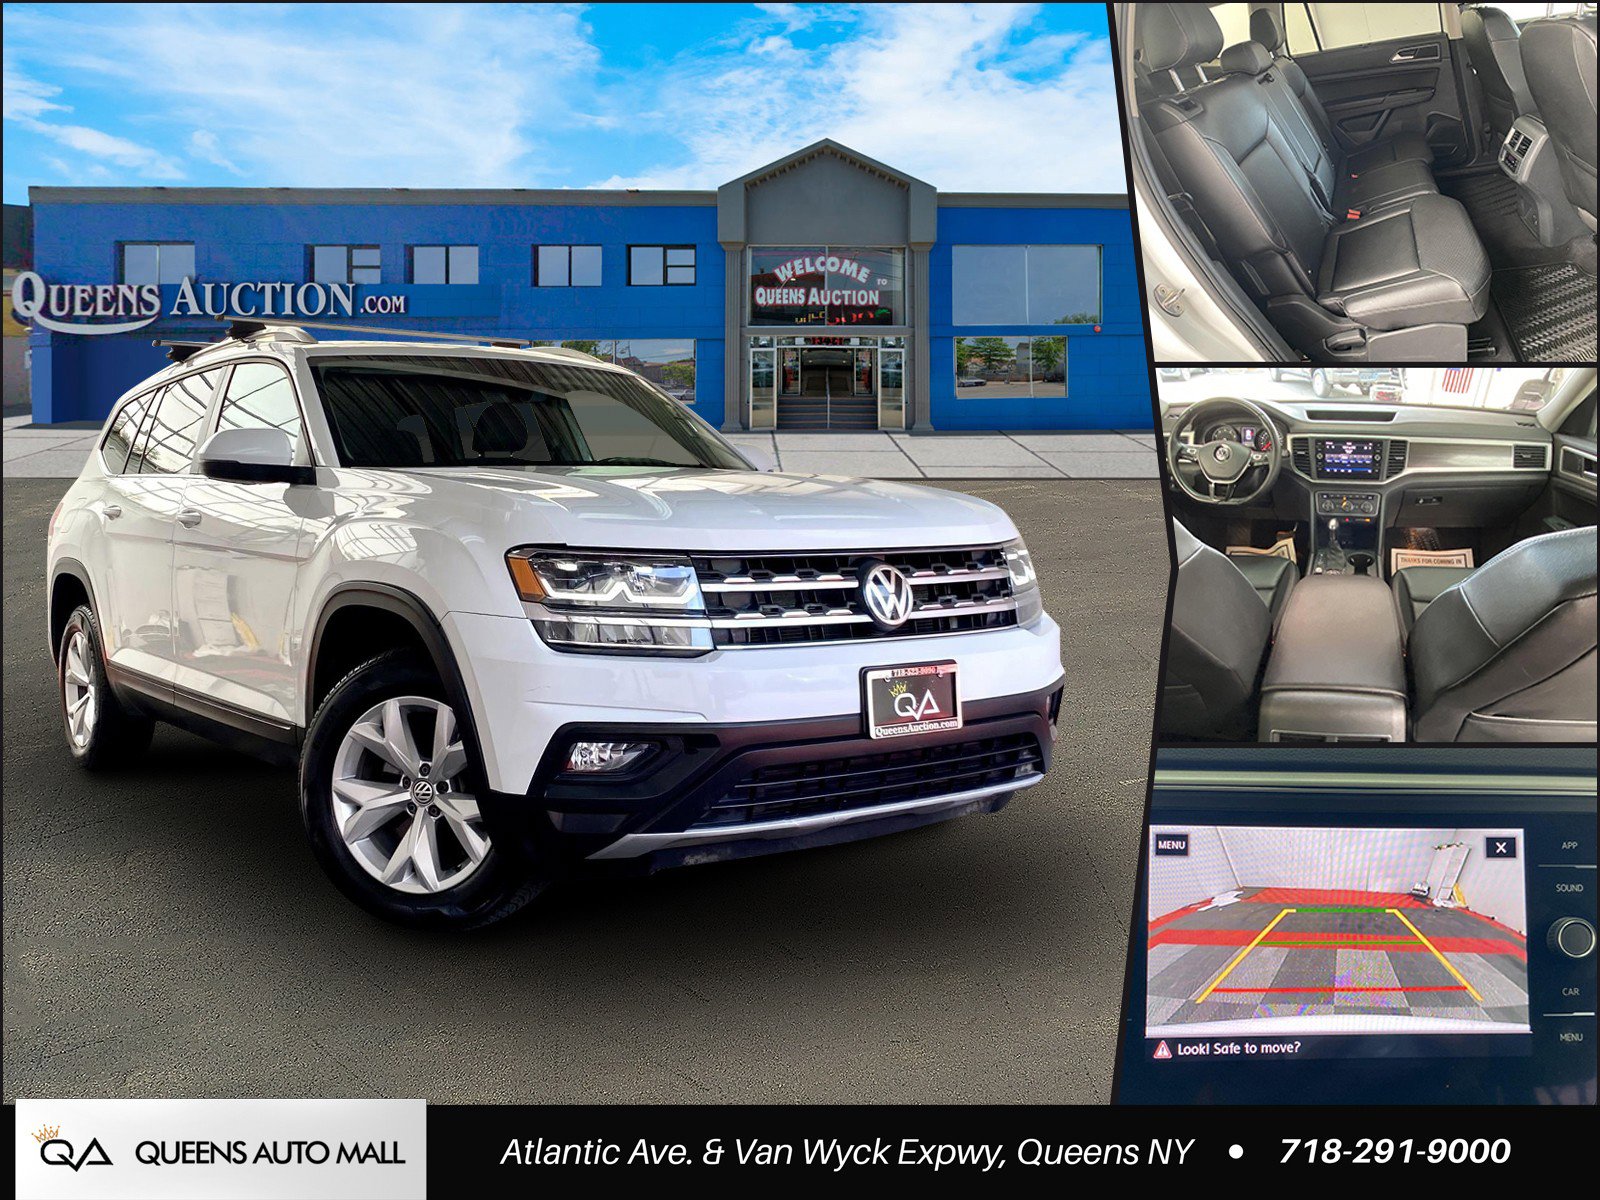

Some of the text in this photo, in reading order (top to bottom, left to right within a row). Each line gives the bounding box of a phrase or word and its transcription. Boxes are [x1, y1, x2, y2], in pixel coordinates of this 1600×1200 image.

[773, 255, 871, 284] WELCOME
[754, 286, 880, 307] QUEENS AUCTION
[11, 271, 161, 335] QUEENS
[1158, 840, 1186, 850] MENU
[1561, 841, 1578, 850] APP
[1555, 883, 1584, 893] SOUND
[1562, 987, 1580, 996] CAR
[1559, 1032, 1584, 1042] MENU
[1213, 1042, 1241, 1055] Safe
[1244, 1042, 1258, 1054] to
[1261, 1041, 1302, 1054] move?
